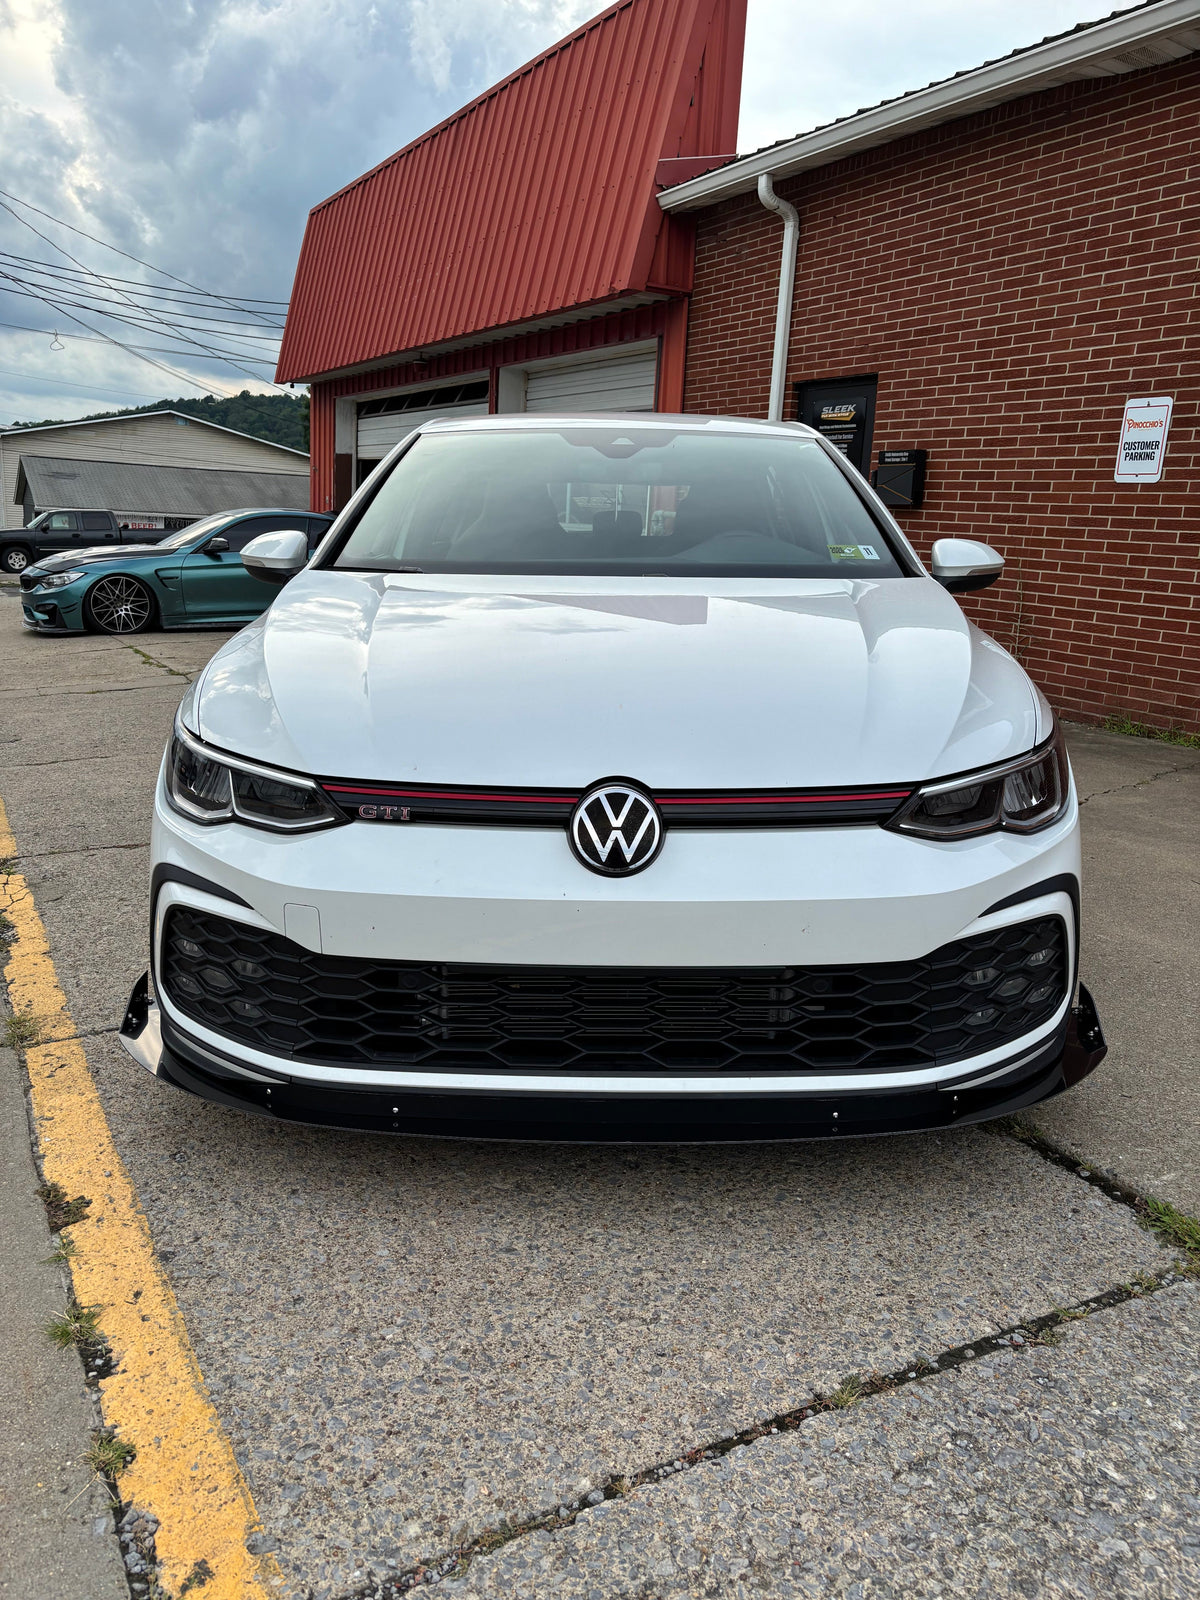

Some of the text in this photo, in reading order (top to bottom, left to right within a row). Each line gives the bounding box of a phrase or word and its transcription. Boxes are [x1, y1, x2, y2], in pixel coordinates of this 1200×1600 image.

[821, 404, 856, 415] SLEEK
[1127, 418, 1163, 433] PINOCCHIO'S
[1123, 440, 1160, 451] CUSTOMER
[1124, 451, 1156, 461] PARKING
[863, 547, 874, 556] 11
[359, 804, 411, 820] GTI
